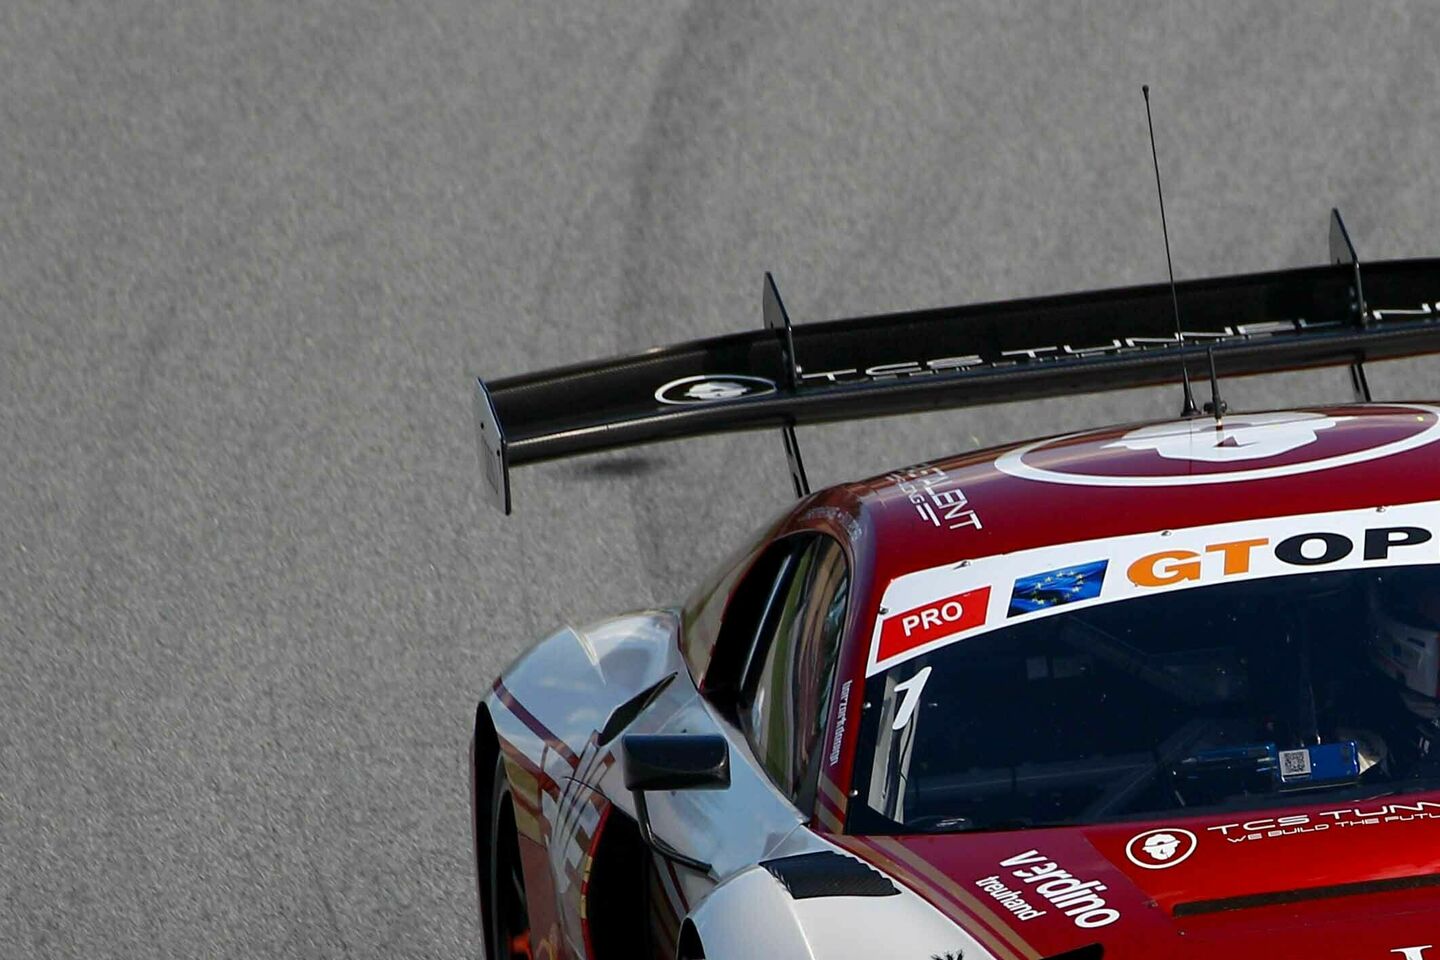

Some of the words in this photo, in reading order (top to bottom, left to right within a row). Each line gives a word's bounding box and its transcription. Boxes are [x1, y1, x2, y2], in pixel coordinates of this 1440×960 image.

[901, 601, 964, 637] PRO
[892, 666, 932, 730] 1
[1207, 814, 1310, 835] TCS
[1227, 832, 1263, 843] WE
[1268, 823, 1330, 838] BUILD
[1335, 817, 1380, 828] THE
[975, 875, 1047, 922] treuhand
